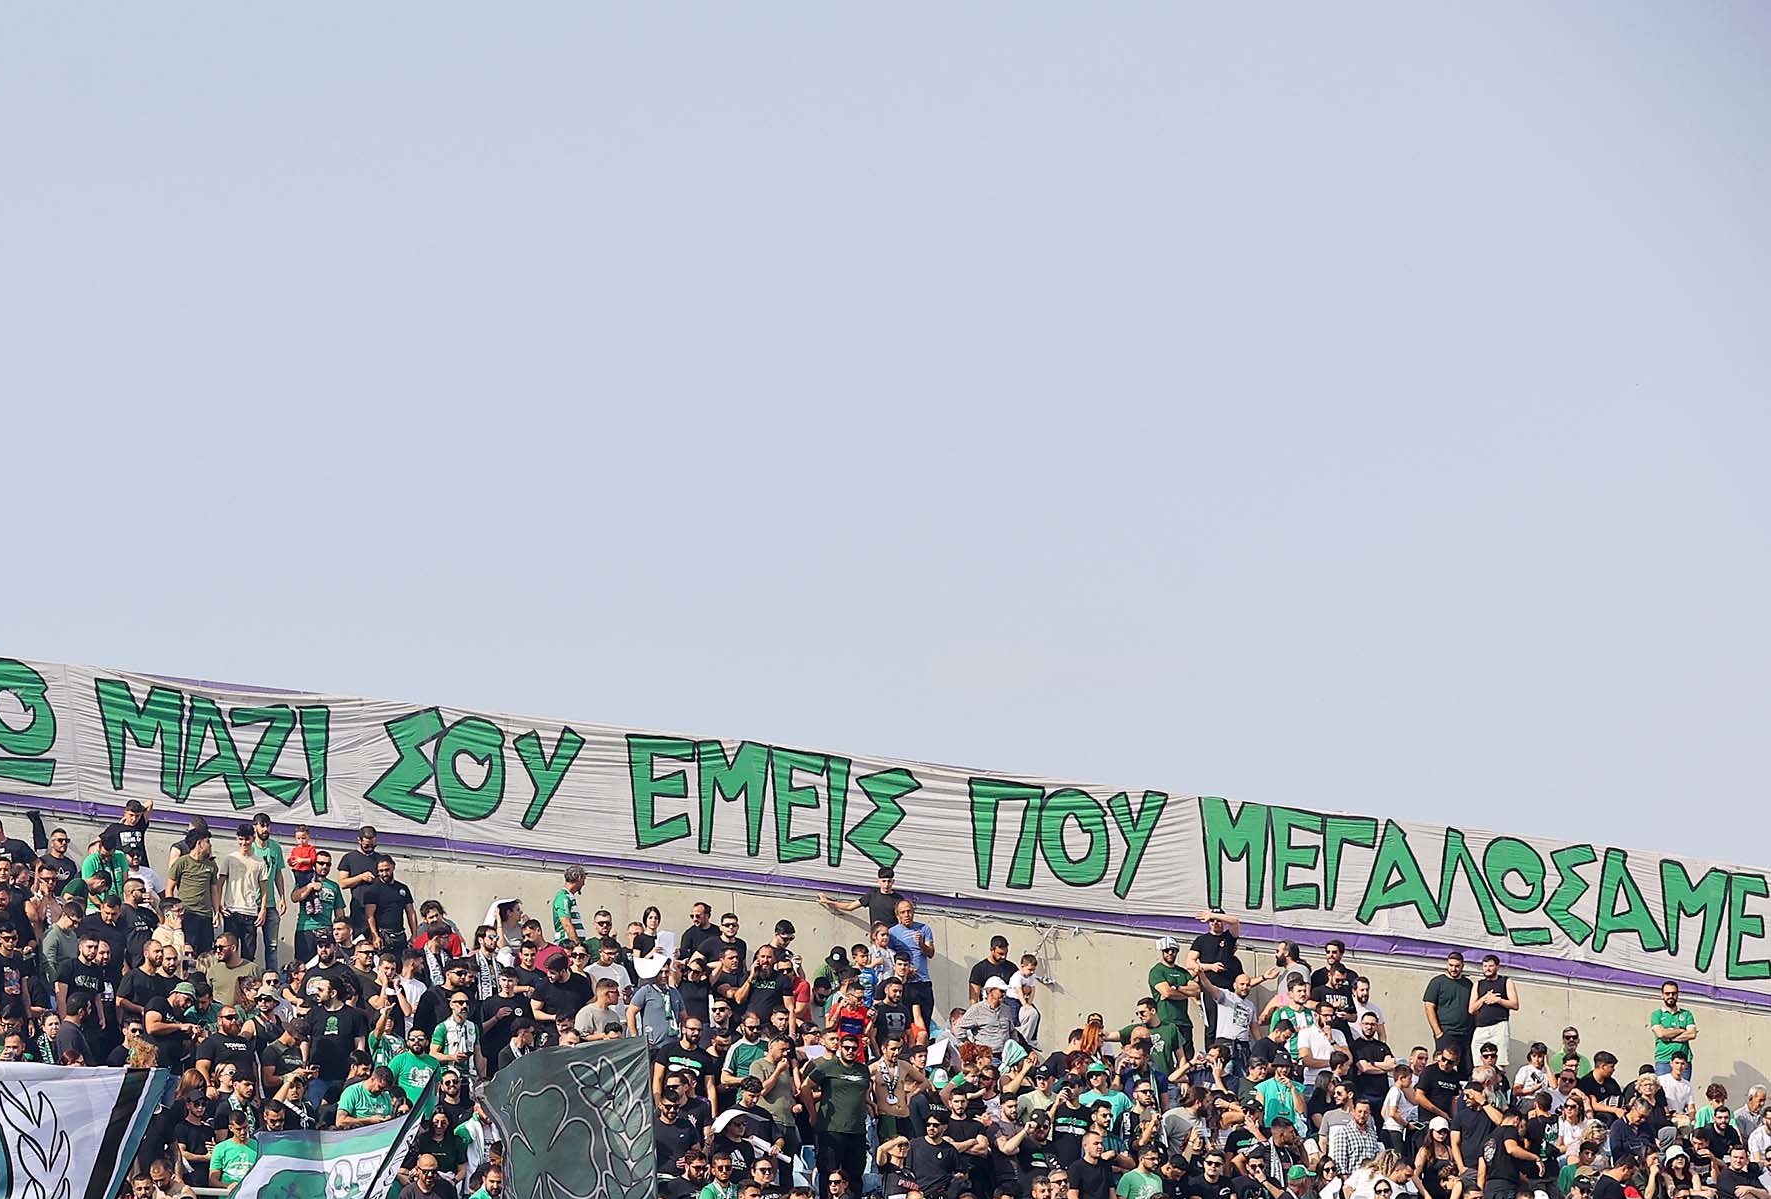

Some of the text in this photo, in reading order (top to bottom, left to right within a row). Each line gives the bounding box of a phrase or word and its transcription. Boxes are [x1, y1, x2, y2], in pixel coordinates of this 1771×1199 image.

[94, 676, 330, 816] ΜΑΖΙ
[364, 705, 586, 831] ΣΟΥ
[626, 733, 923, 869] ΕΜΕΙΣ
[968, 776, 1169, 900] ΠΟΥ
